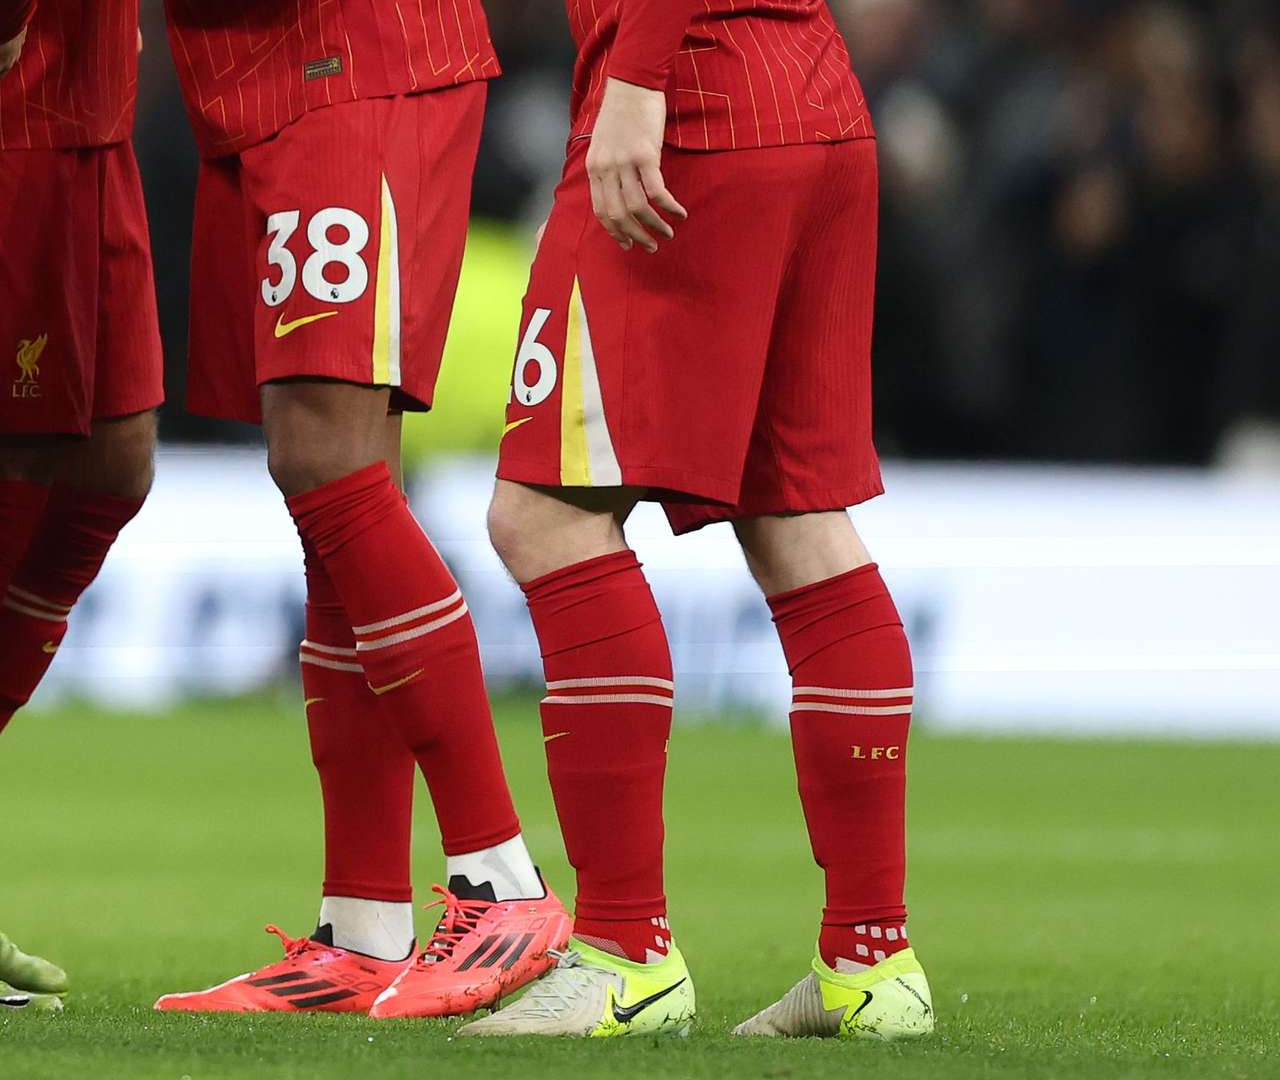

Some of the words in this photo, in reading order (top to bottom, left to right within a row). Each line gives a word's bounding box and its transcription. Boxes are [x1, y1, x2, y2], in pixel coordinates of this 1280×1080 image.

[261, 206, 370, 307] 38
[509, 307, 558, 407] 6
[850, 745, 900, 760] LFC
